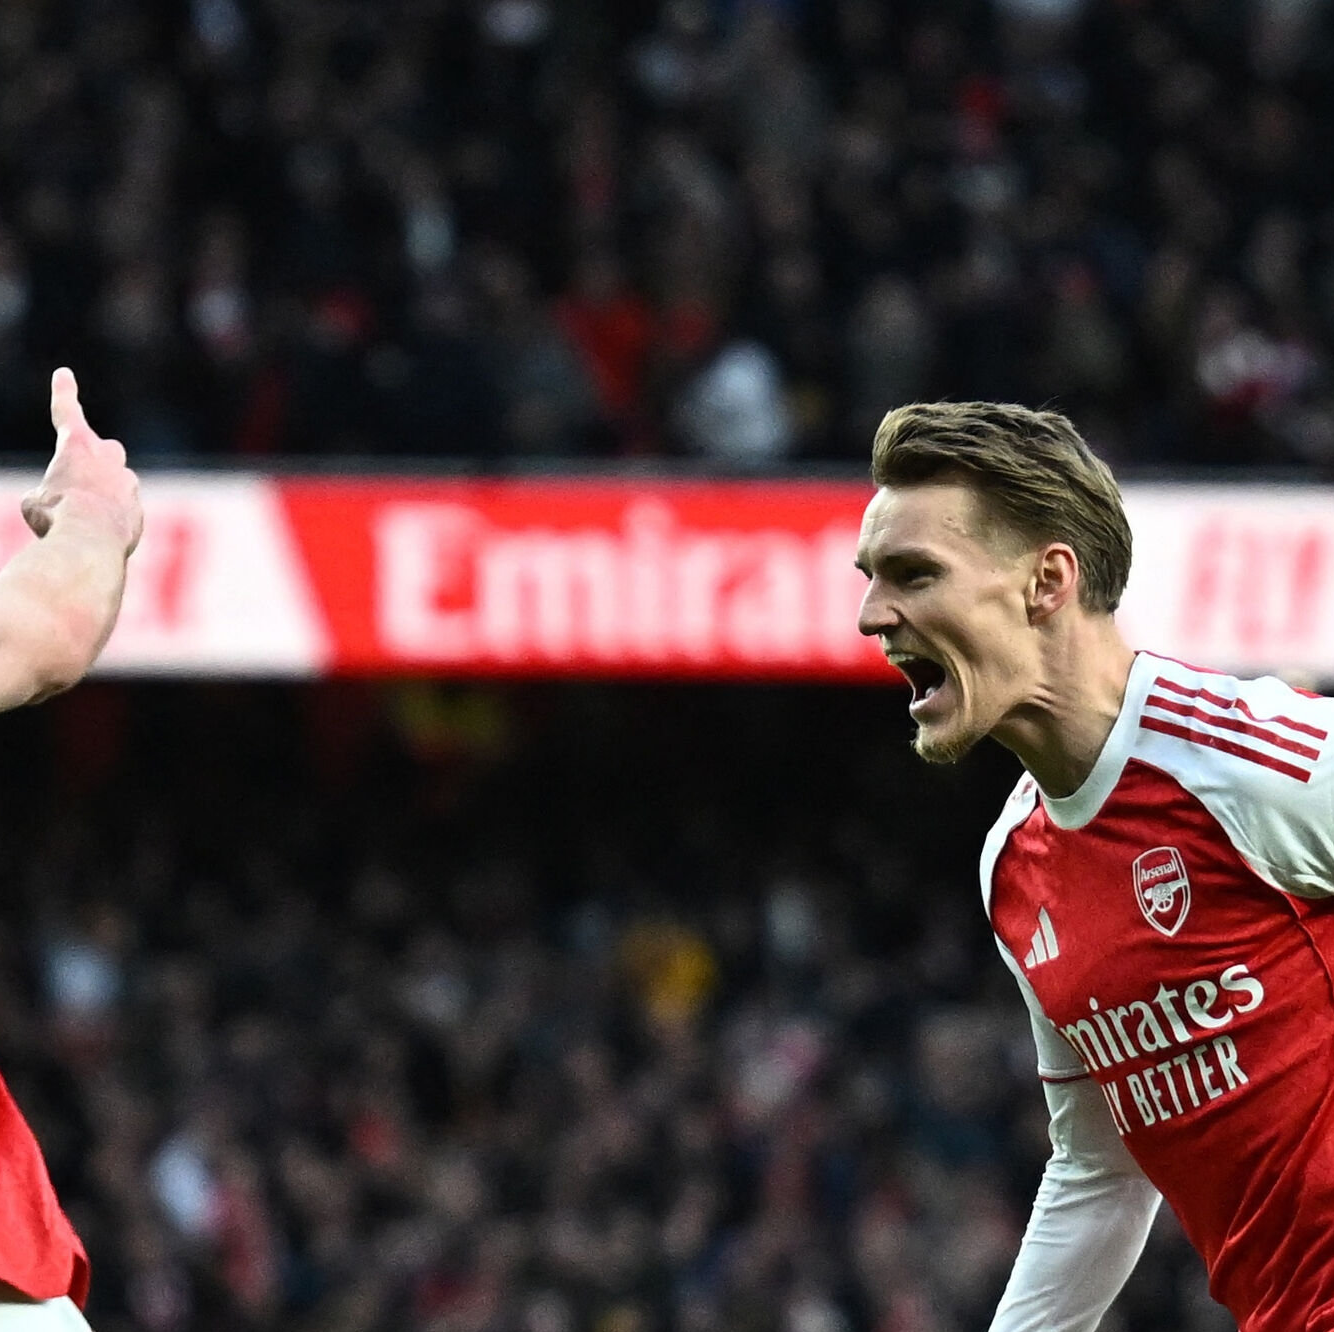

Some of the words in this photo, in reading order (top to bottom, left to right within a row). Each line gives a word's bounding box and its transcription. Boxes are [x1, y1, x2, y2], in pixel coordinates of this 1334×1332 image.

[370, 498, 867, 666] Emirat
[1049, 964, 1265, 1073] mirates
[1126, 1034, 1249, 1127] BETTER
